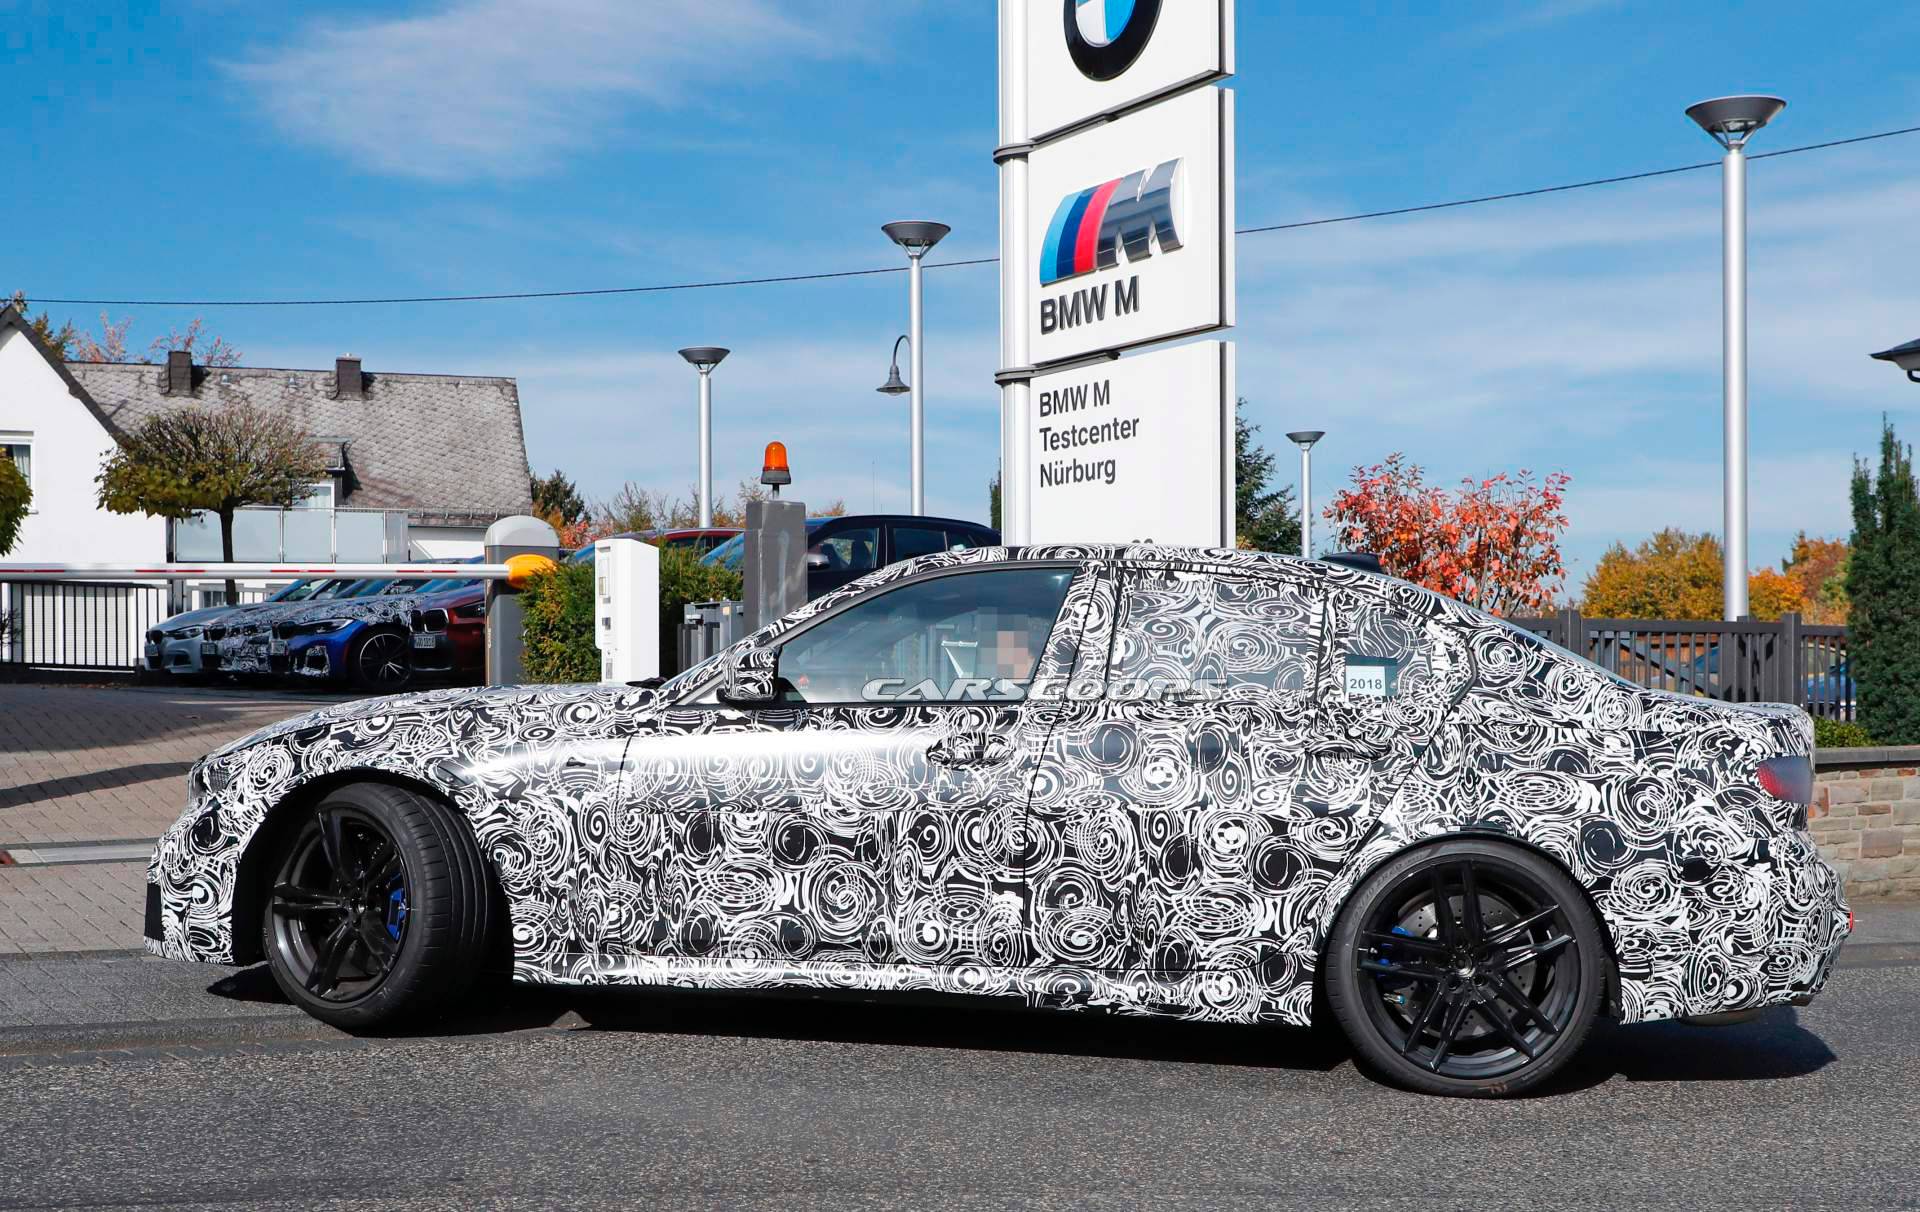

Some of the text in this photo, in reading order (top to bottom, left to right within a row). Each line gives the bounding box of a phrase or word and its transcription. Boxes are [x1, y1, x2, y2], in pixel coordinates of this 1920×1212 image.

[1040, 275, 1139, 335] BMW M
[1040, 379, 1110, 418] BMW M
[1039, 417, 1140, 452] Testcenter
[1040, 458, 1116, 488] Nürburg
[1350, 678, 1383, 690] 2018
